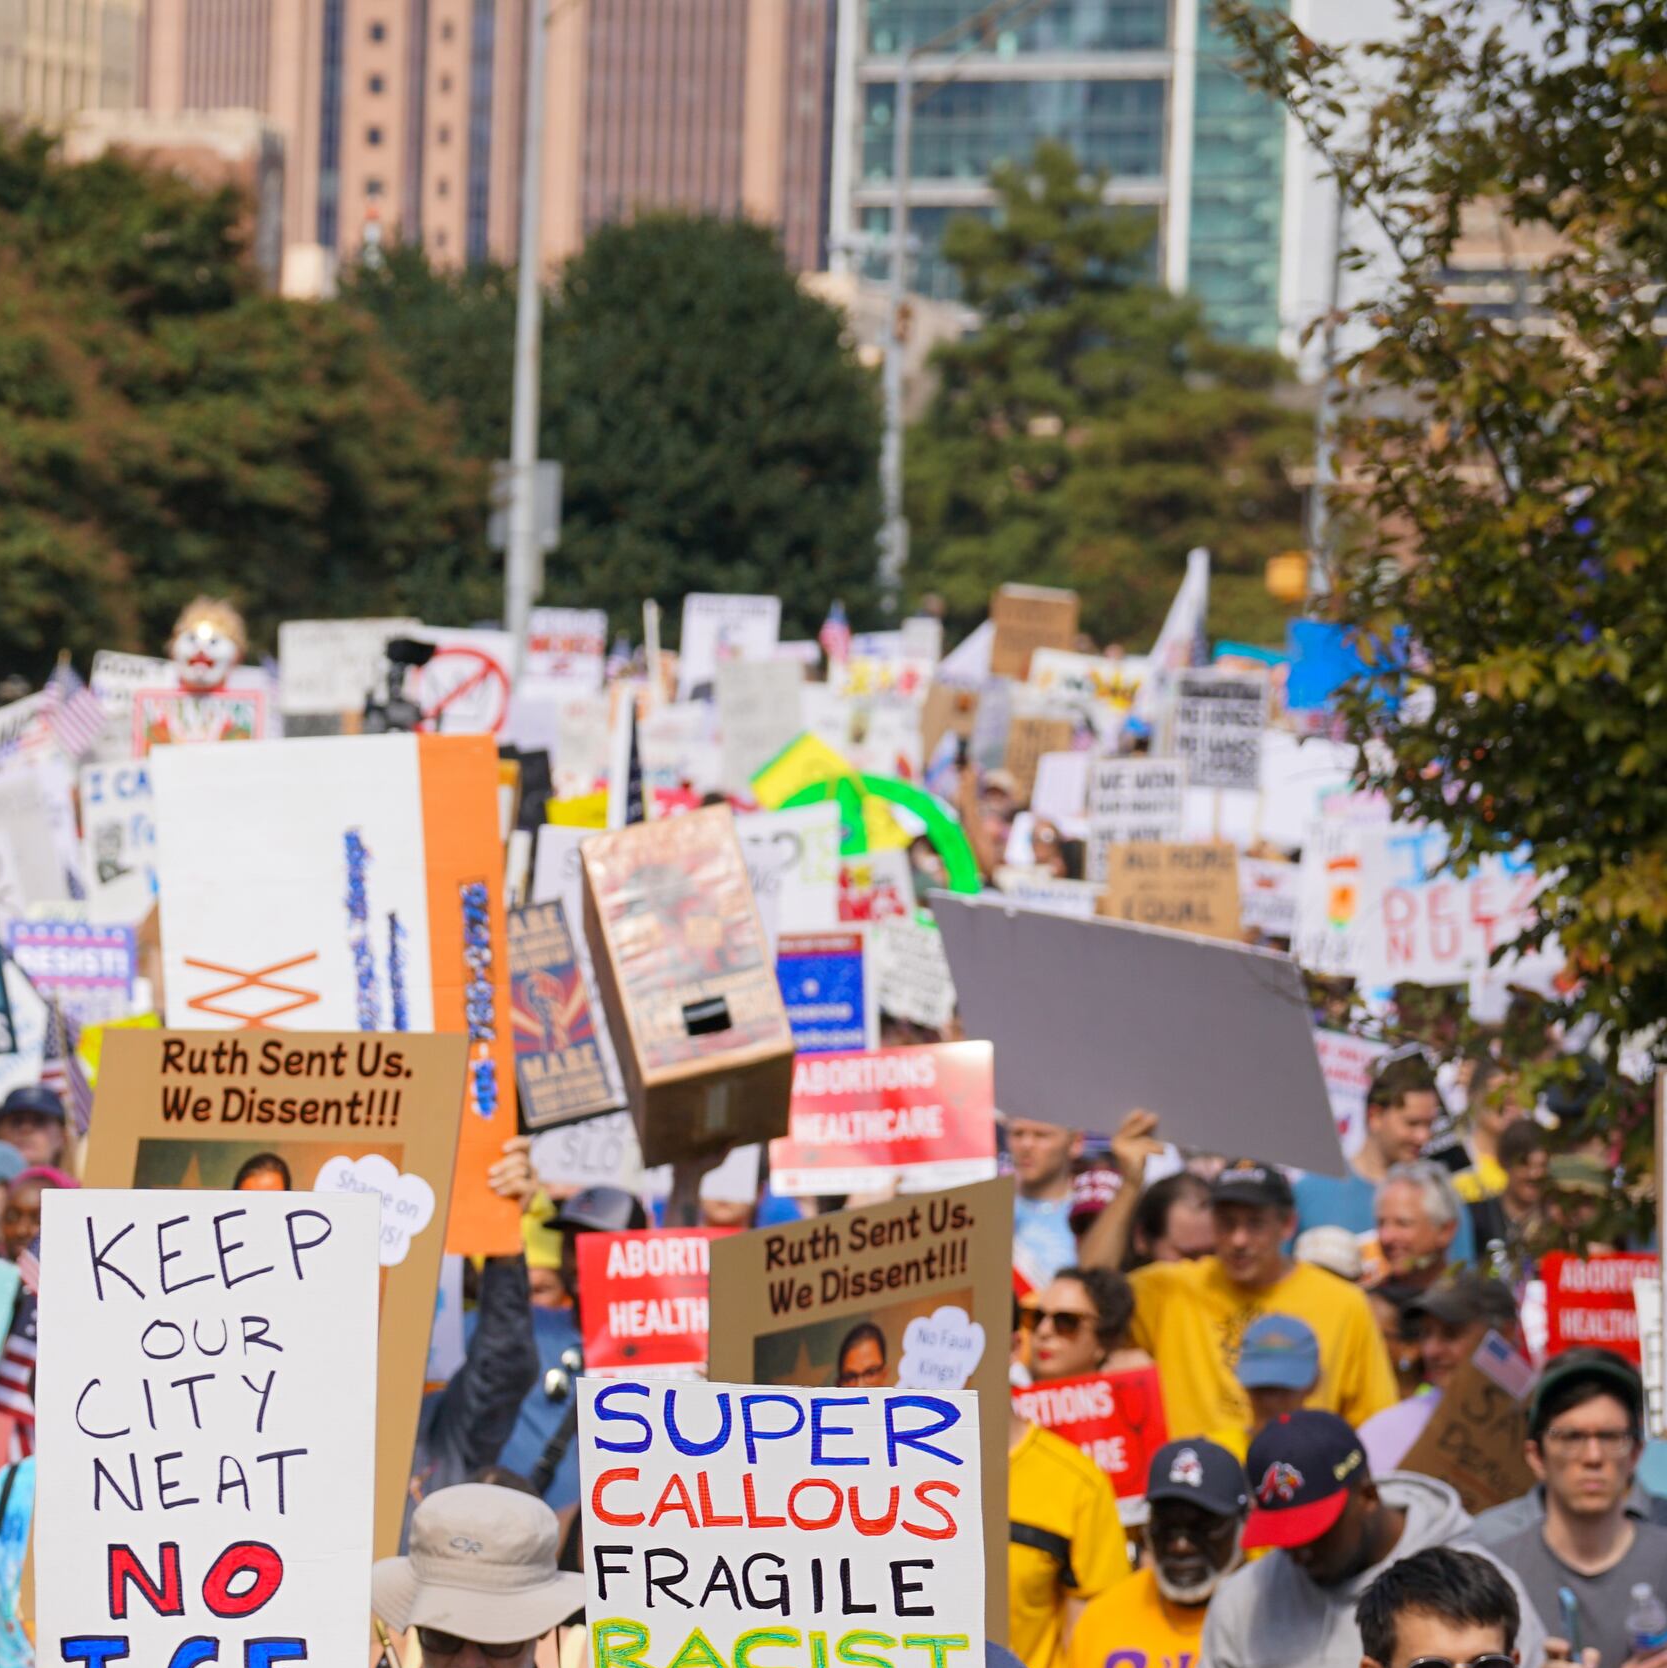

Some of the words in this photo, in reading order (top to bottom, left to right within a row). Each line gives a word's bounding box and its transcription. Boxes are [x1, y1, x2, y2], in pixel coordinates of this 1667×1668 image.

[160, 1039, 249, 1079] Ruth
[258, 1042, 348, 1080] Sent
[357, 1042, 413, 1080] Us.
[794, 1054, 936, 1093] ABORTIONS
[161, 1087, 213, 1124] We
[219, 1088, 402, 1128] Dissent!!!
[791, 1103, 945, 1146] HEALTHCARE
[86, 1208, 333, 1301] KEEP
[605, 1236, 709, 1281] ABORTI
[764, 1229, 841, 1273] Ruth
[849, 1211, 922, 1251] Sent
[928, 1199, 976, 1233] Us.
[769, 1280, 814, 1317] We
[818, 1238, 969, 1306] Dissent!!!
[140, 1314, 284, 1360] OUR
[608, 1299, 709, 1339] HEALTH
[915, 1327, 938, 1347] No
[1558, 1307, 1639, 1341] HEALTH
[75, 1368, 278, 1440] CITY
[593, 1382, 964, 1468] SUPER
[92, 1447, 309, 1515] NEAT
[590, 1466, 962, 1541] CALLOUS
[107, 1539, 284, 1620] NO
[593, 1545, 935, 1618] FRAGILE
